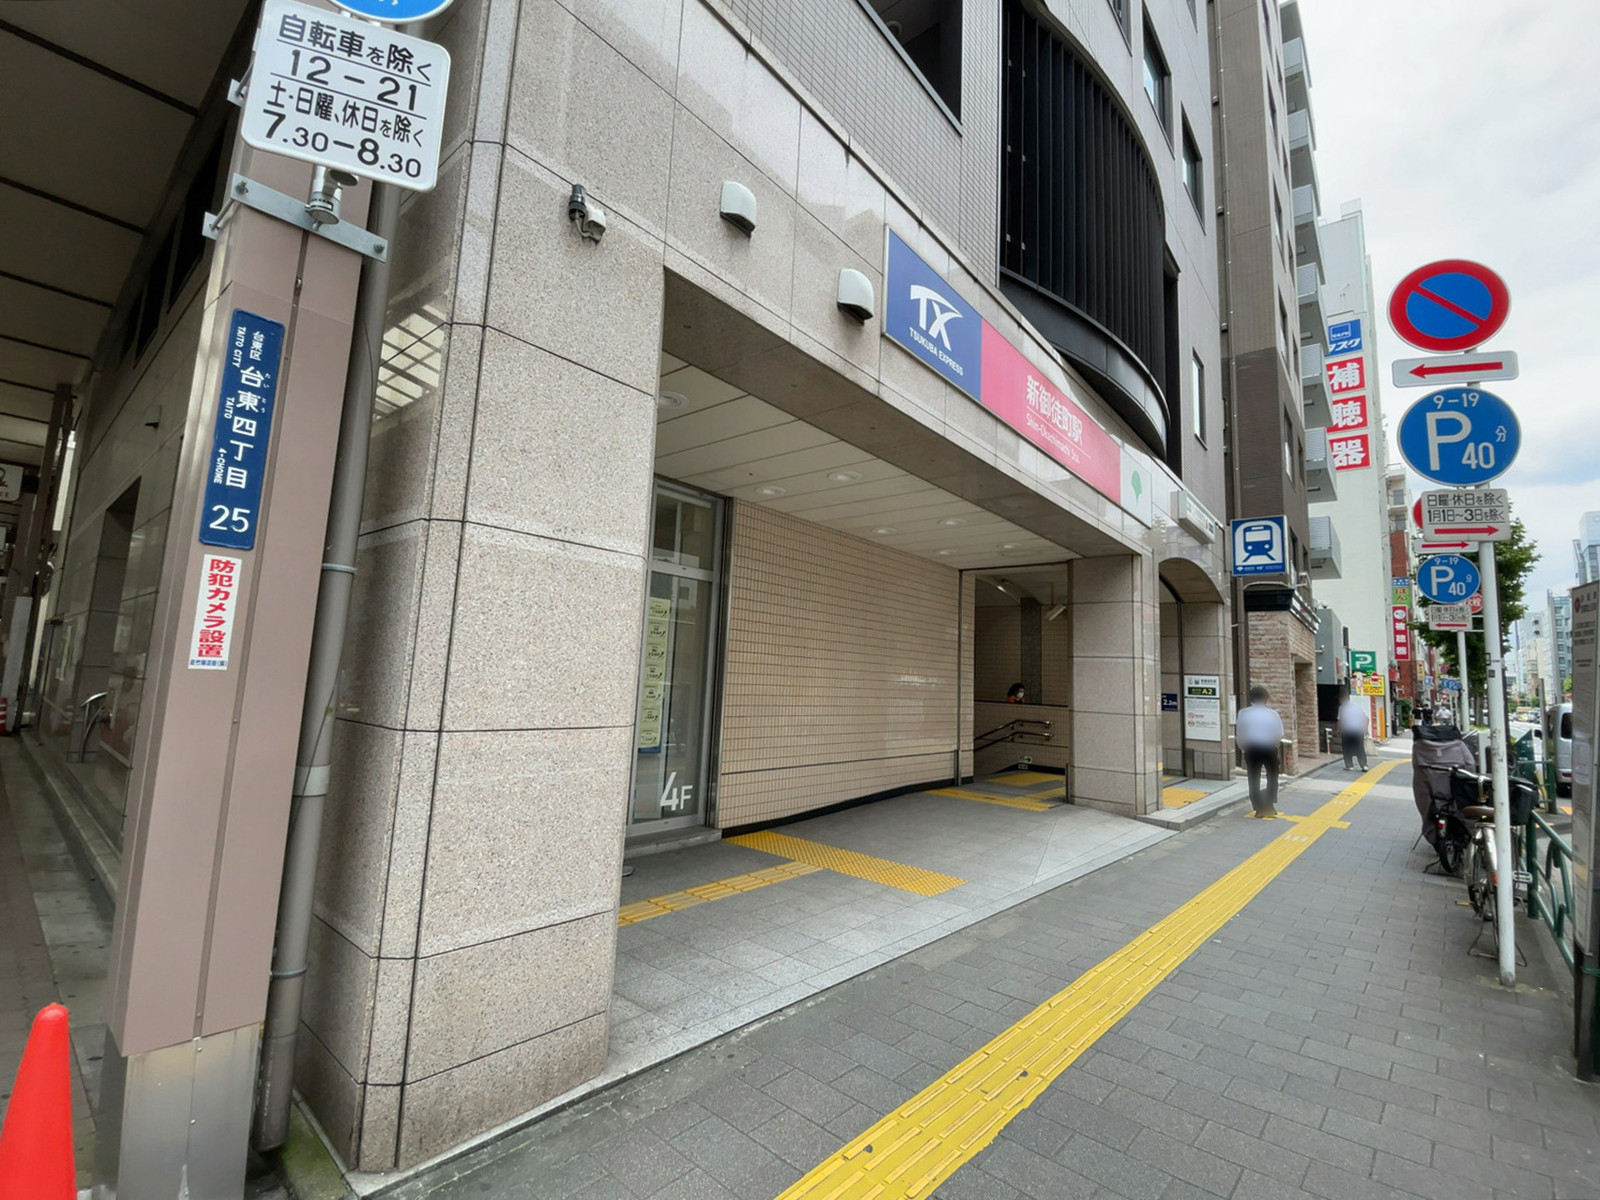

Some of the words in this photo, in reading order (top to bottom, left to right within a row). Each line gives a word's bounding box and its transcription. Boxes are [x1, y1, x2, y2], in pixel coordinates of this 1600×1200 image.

[278, 13, 433, 83] 自転車を除く
[235, 326, 247, 348] TAITO
[910, 284, 964, 351] TX
[232, 349, 243, 368] CITY
[249, 330, 265, 361] 台東区
[909, 327, 938, 357] TSUKUBA
[938, 350, 964, 376] EXPRESS
[224, 397, 235, 419] TAITO
[1026, 374, 1083, 447] 新御徒町駅
[1328, 362, 1366, 467] 補聴器
[1433, 392, 1480, 410] 9-19
[226, 366, 264, 489] 台東四丁目
[1426, 410, 1472, 471] P
[1461, 442, 1496, 470] 40
[1495, 425, 1507, 443] 分
[209, 504, 251, 533] 25
[1430, 566, 1455, 596] P
[1448, 582, 1467, 596] 40
[197, 558, 236, 658] 防犯カメラ設置
[659, 772, 694, 811] 4F
